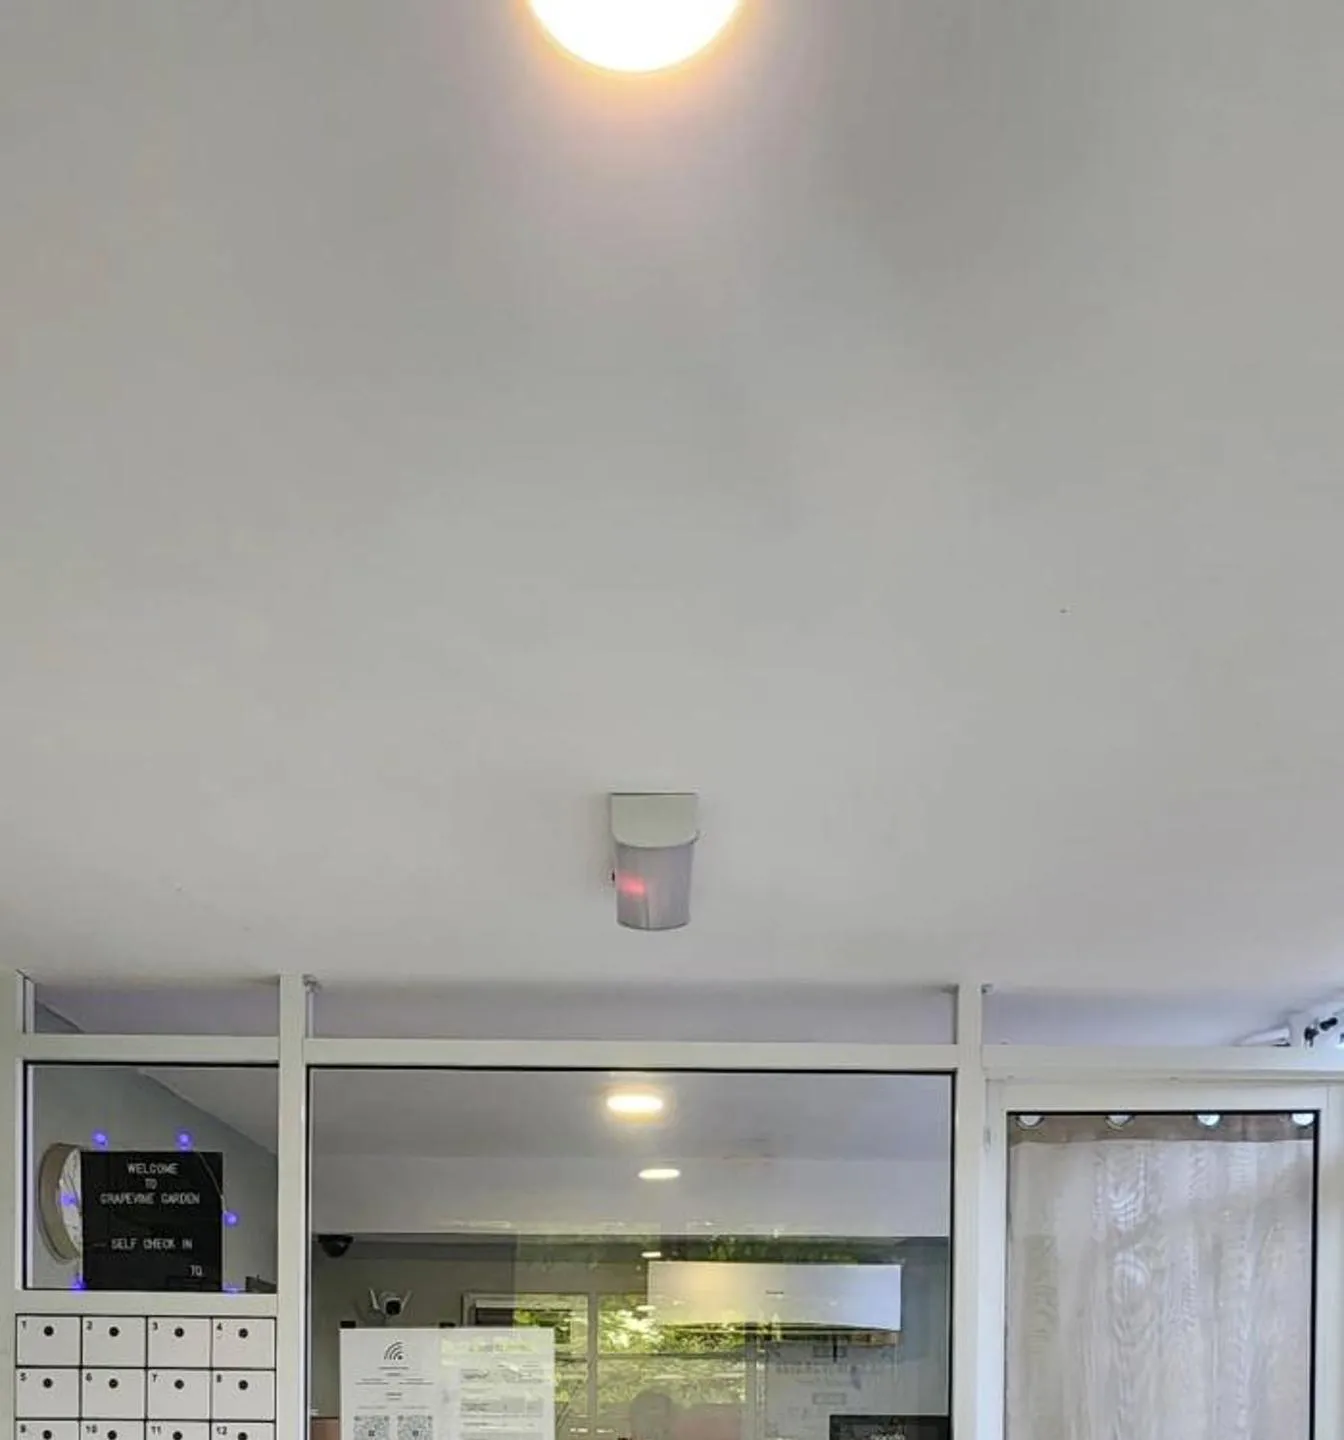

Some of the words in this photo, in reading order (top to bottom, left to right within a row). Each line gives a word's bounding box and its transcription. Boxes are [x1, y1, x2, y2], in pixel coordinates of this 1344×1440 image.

[127, 1162, 180, 1175] WELCOME
[145, 1178, 158, 1190] TO
[100, 1191, 155, 1205] GRAPEVINE
[160, 1191, 201, 1205] GARDEN
[110, 1237, 137, 1250] SELF
[142, 1237, 176, 1250] CHECK
[181, 1237, 194, 1250] IN
[21, 1320, 27, 1329] 1
[86, 1320, 93, 1331] 2
[216, 1322, 223, 1331] 4
[151, 1373, 159, 1383] 7
[85, 1424, 98, 1434] 10
[150, 1425, 162, 1435] 11
[215, 1425, 228, 1436] 12
